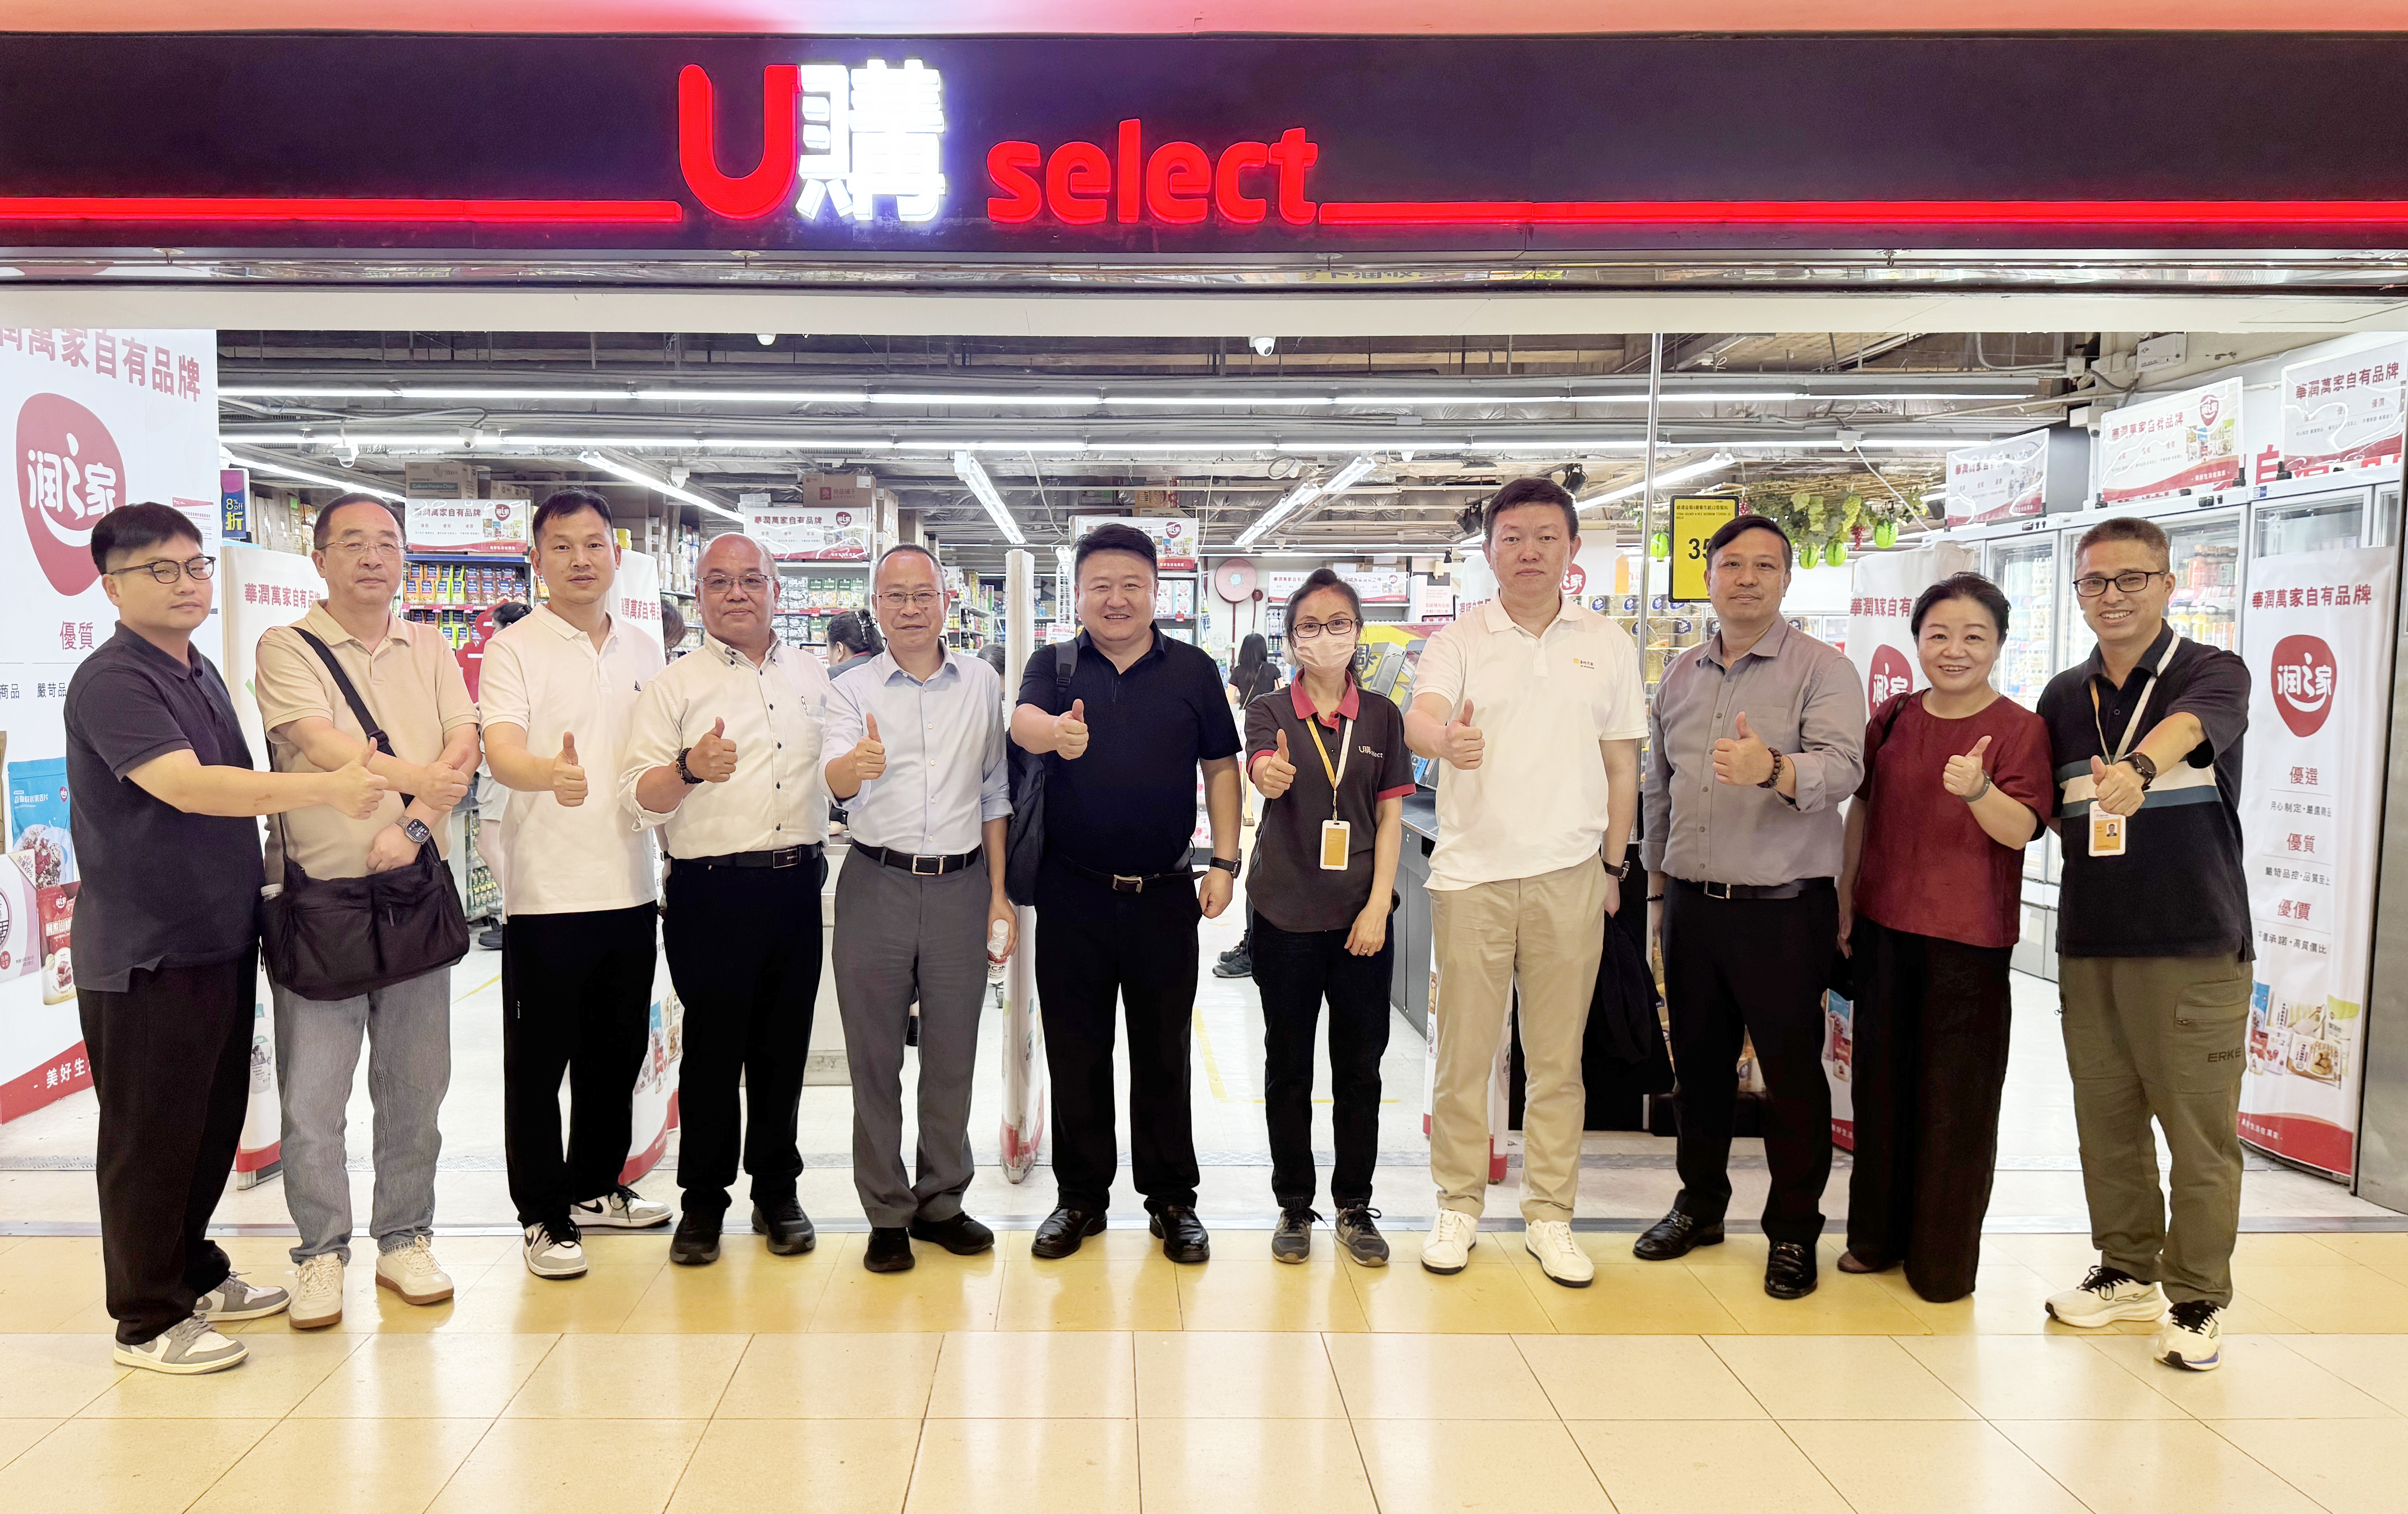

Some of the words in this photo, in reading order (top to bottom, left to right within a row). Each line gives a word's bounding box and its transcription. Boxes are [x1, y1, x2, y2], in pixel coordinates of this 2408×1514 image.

[986, 118, 1319, 225] select
[2296, 362, 2399, 400] 華潤萬家自有品牌
[225, 511, 244, 531] 折
[2252, 584, 2372, 610] 華潤萬家自有品牌
[60, 621, 94, 650] 優質
[2277, 652, 2332, 698] 润之家
[2290, 766, 2318, 785] 優選
[2287, 833, 2315, 853] 優質
[2278, 899, 2311, 921] 優價
[2208, 1047, 2241, 1062] ERKE
[47, 1057, 91, 1089] 美好生
